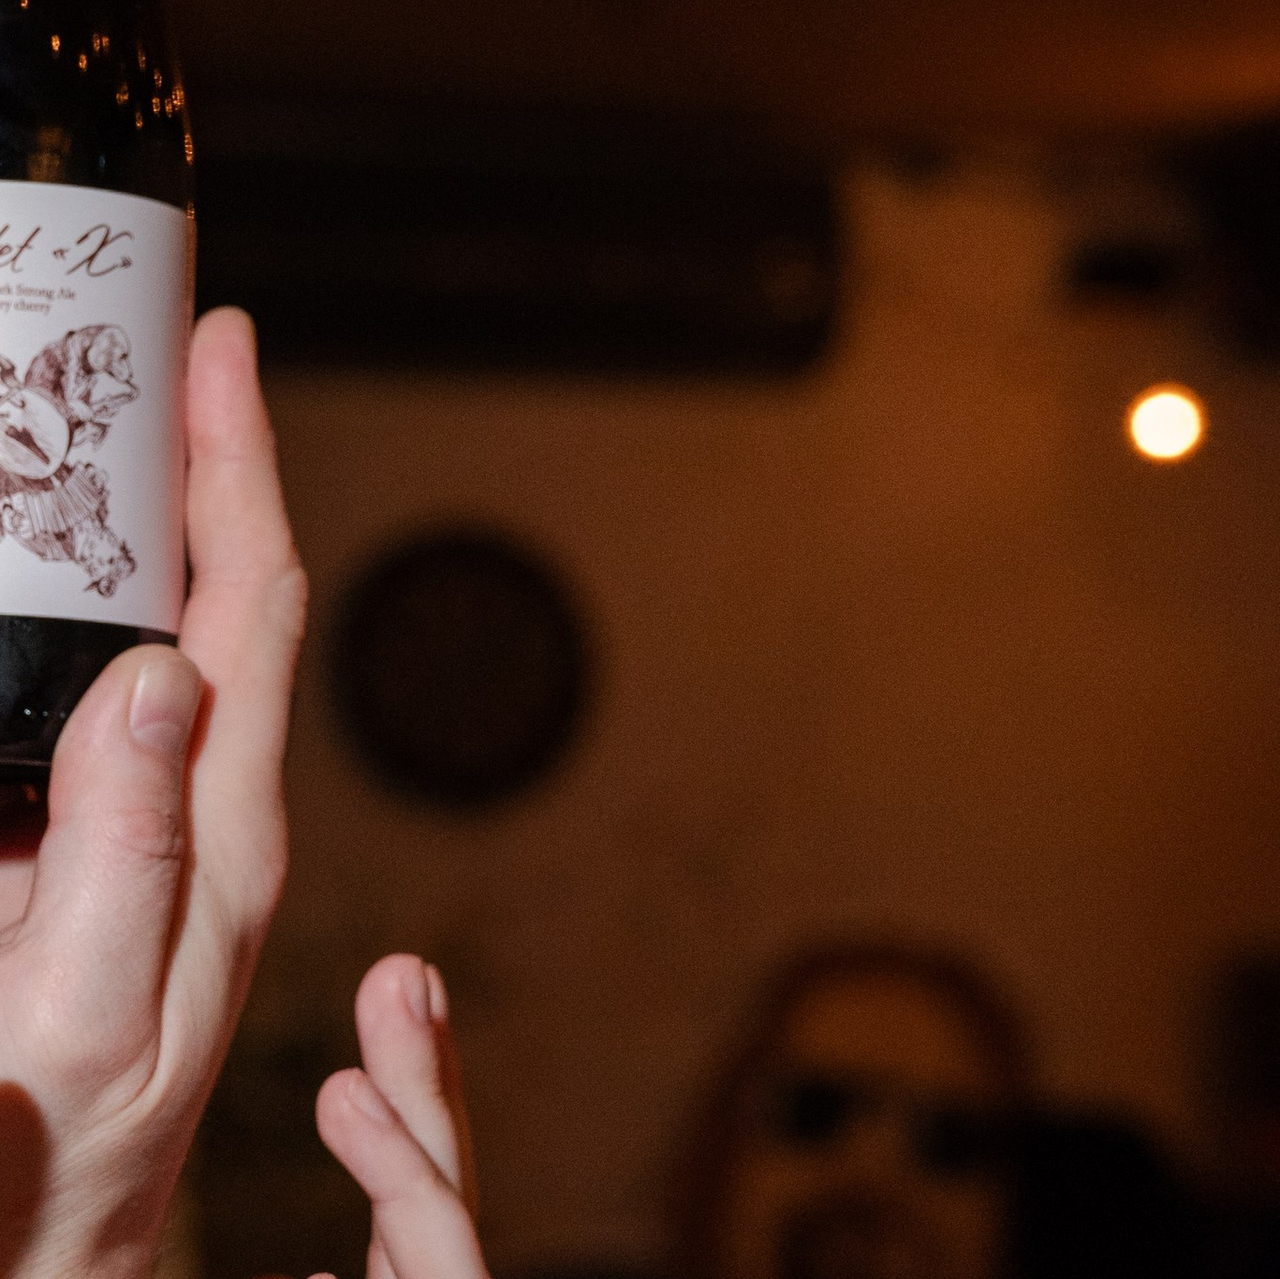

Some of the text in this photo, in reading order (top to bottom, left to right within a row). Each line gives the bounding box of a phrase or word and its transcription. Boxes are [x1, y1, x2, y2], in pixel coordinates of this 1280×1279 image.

[16, 283, 55, 301] Strong
[57, 287, 78, 301] Ale
[13, 298, 52, 316] cherry
